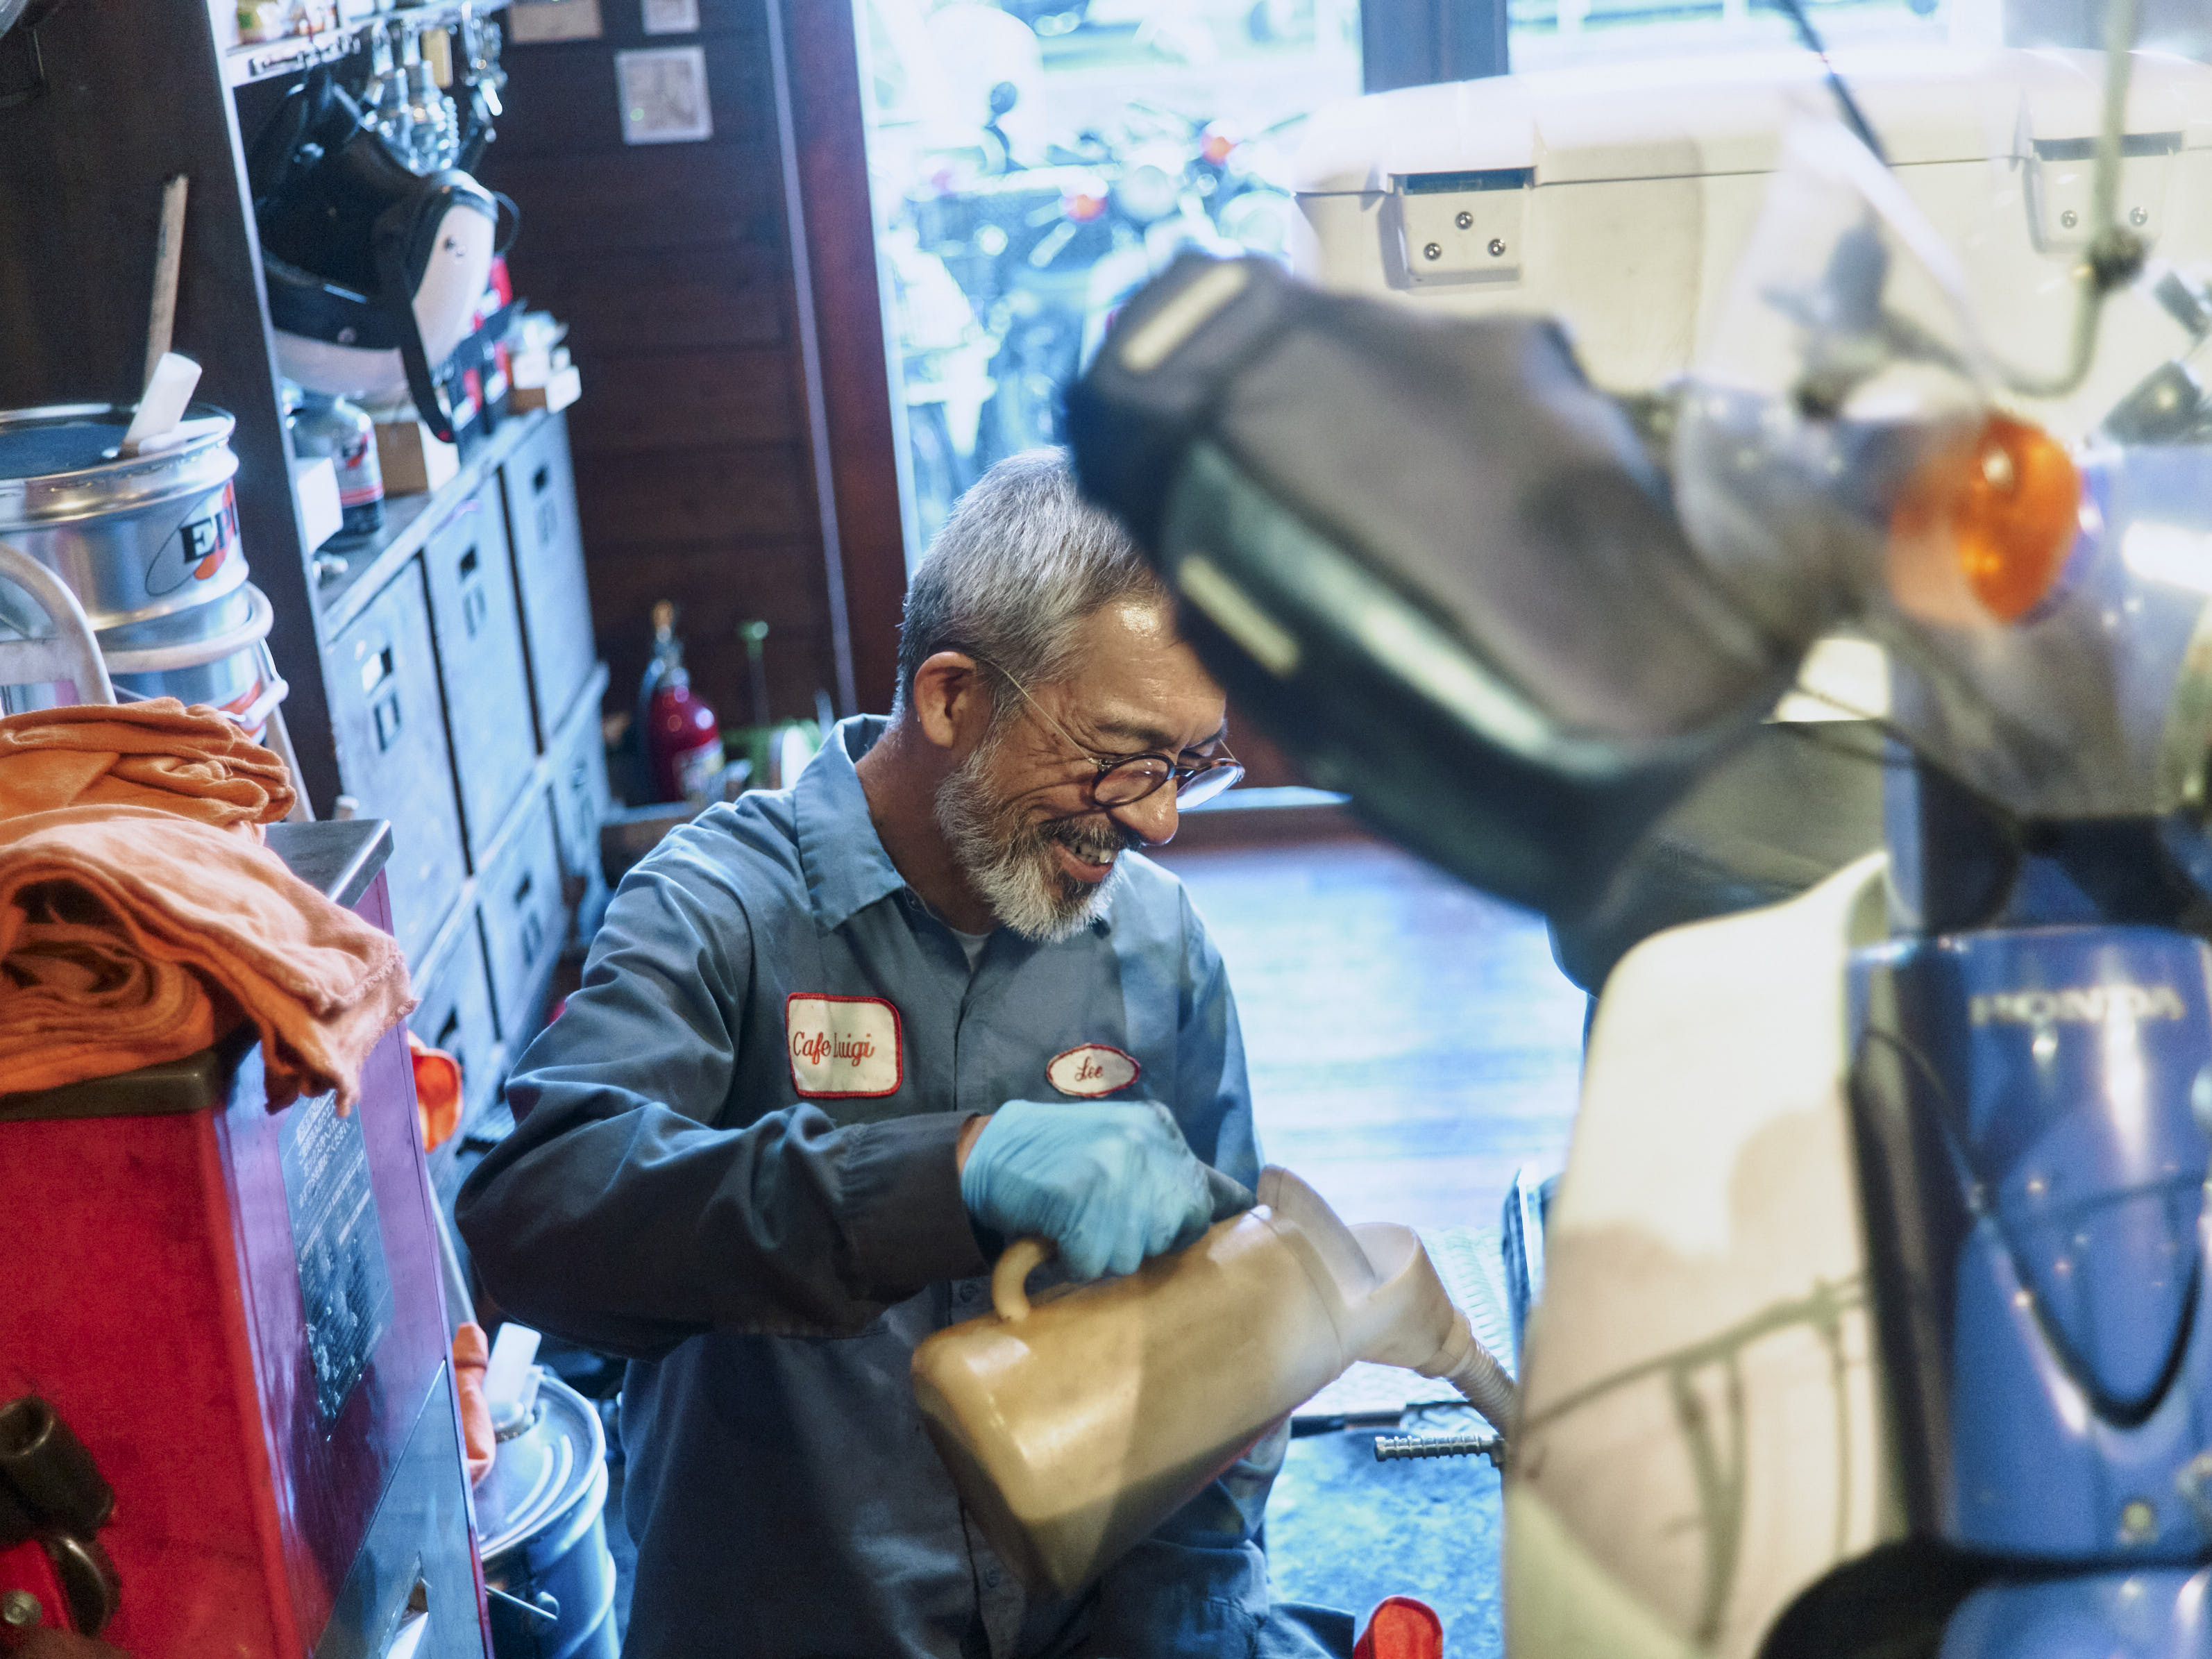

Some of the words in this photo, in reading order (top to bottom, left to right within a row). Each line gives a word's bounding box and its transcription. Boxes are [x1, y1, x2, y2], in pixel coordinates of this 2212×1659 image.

[1969, 986, 2186, 1028] HONDA
[793, 1031, 831, 1065] Cafe
[1074, 1056, 1103, 1081] Lee
